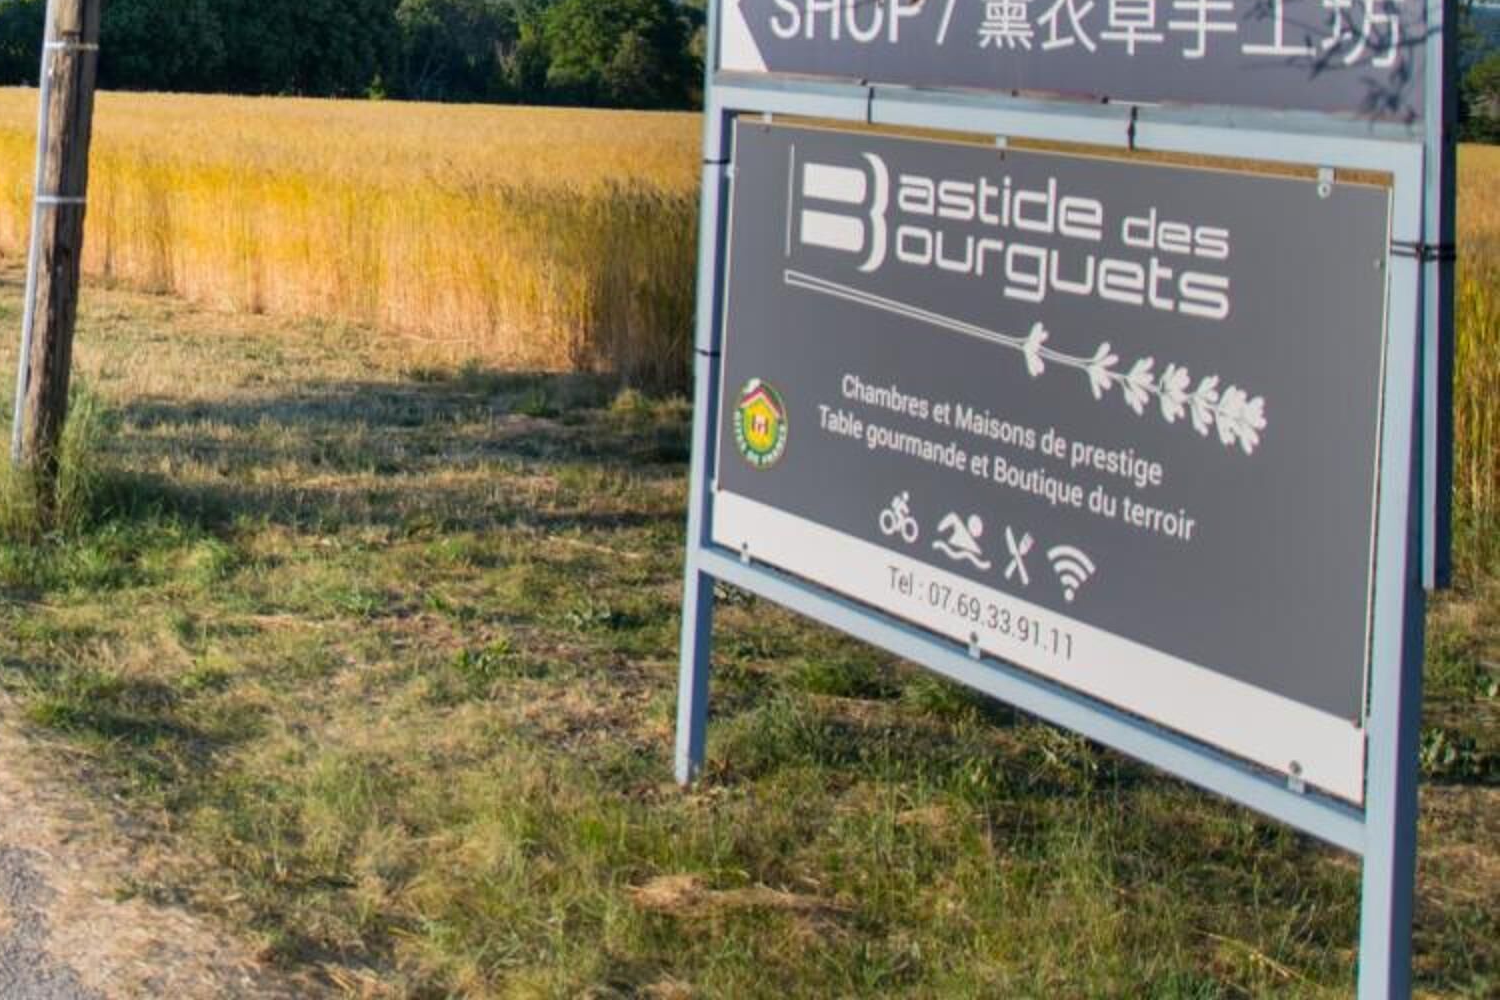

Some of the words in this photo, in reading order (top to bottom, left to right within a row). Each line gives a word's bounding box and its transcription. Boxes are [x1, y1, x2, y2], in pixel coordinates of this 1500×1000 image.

[1121, 207, 1230, 260] des
[818, 404, 863, 439] Table
[866, 424, 967, 470] gourmande
[970, 454, 989, 478] et
[993, 456, 1084, 505] Boutique
[1088, 485, 1117, 517] du
[1123, 497, 1195, 541] terroir
[841, 374, 929, 419] Chambres
[932, 403, 951, 425] et
[954, 404, 1037, 450] Maisons
[1041, 427, 1067, 459] de
[1071, 441, 1163, 488] prestige
[887, 565, 913, 595] Tel
[928, 581, 1072, 660] 07.69.33.91.11
